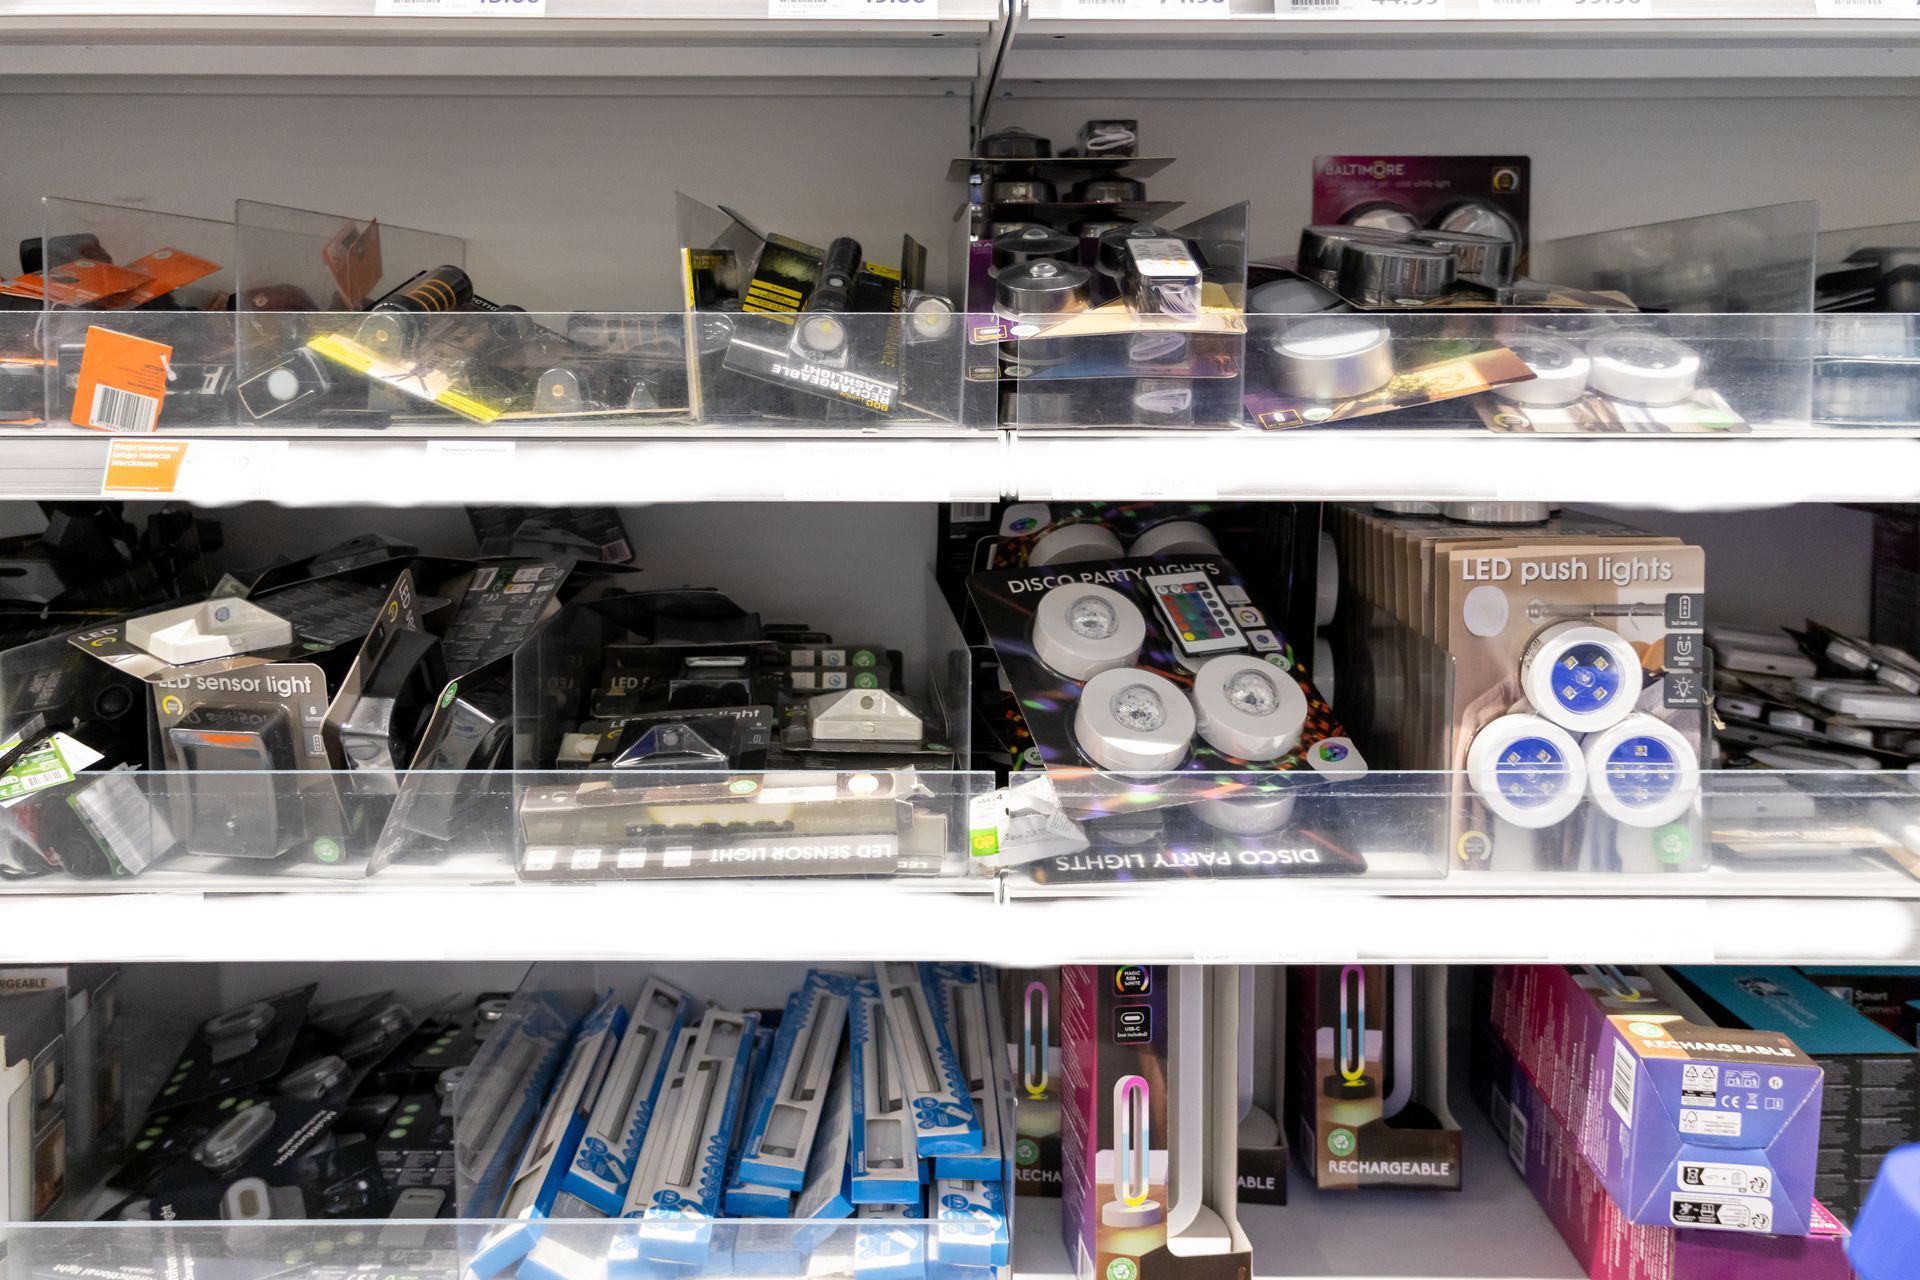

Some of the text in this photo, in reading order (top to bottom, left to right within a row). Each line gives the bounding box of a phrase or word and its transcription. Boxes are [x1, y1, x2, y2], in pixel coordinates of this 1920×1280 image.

[1325, 162, 1405, 177] BALTIMORE
[771, 364, 890, 406] RECHARGEABLE
[801, 363, 891, 397] FLASHLIGHT
[1008, 574, 1075, 594] DISCO
[1080, 567, 1143, 586] PARTY
[1462, 556, 1673, 586] LED push lights
[398, 578, 411, 609] LED
[78, 627, 119, 642] LED
[196, 676, 261, 693] sensor
[266, 675, 312, 698] light
[611, 677, 638, 689] LED
[975, 834, 996, 849] GP
[709, 843, 892, 863] LED SENSOR LIGHT
[1055, 848, 1320, 871] DISCO PARTY LIGHTS
[1855, 990, 1888, 1001] Smart
[1642, 1039, 1797, 1058] RECHARGEABLE
[1014, 1168, 1062, 1184] RECHA
[1328, 1159, 1450, 1178] RECHARGEABLE
